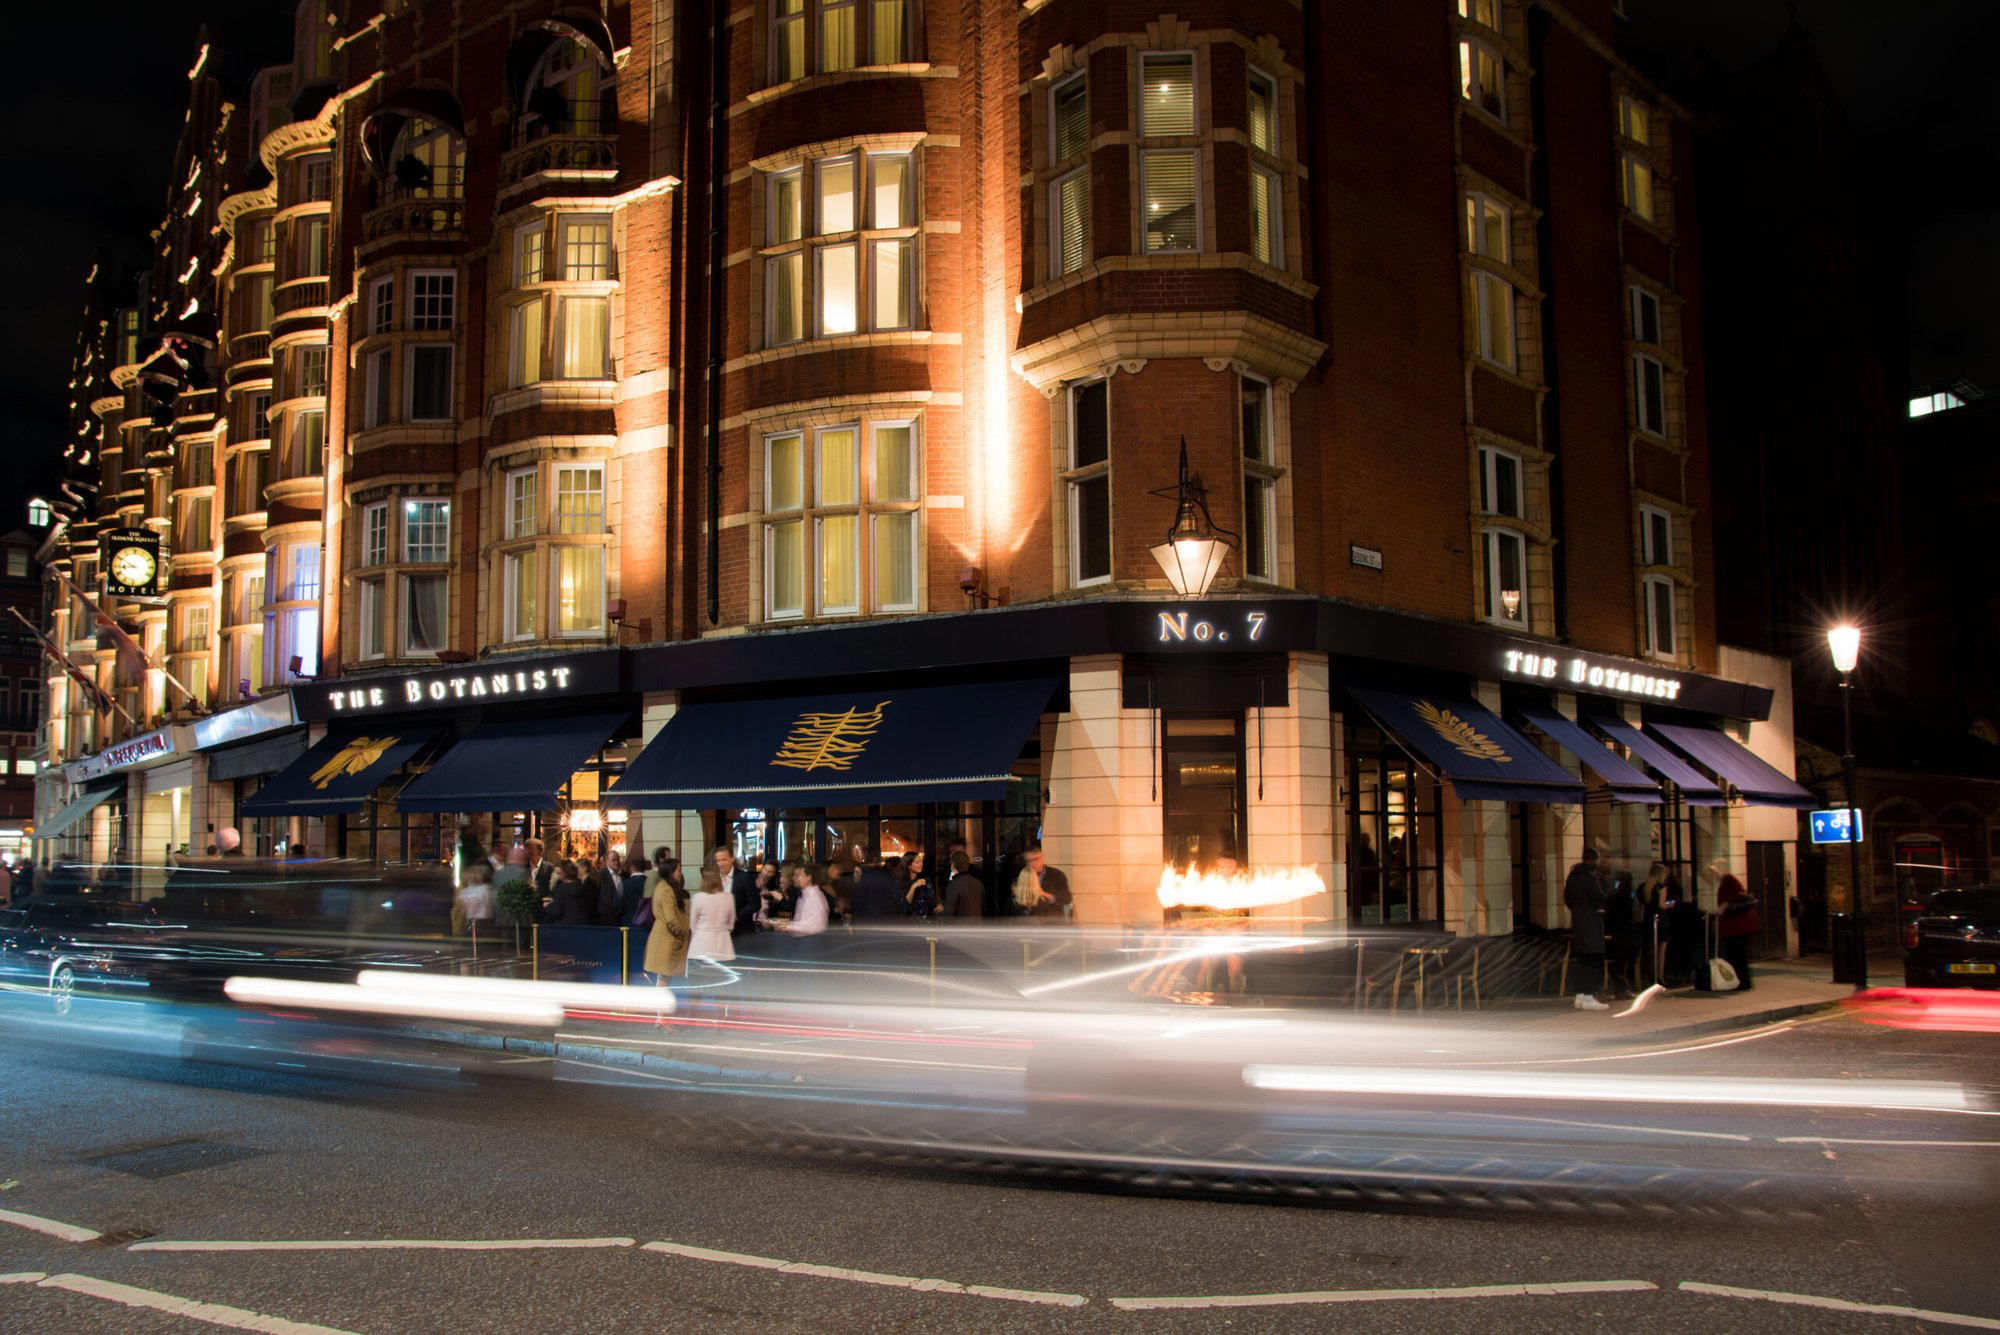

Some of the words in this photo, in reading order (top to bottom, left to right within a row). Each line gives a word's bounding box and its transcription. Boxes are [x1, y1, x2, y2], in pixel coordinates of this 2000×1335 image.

[109, 586, 155, 594] HOTEL
[1159, 612, 1229, 641] No.
[1247, 612, 1267, 641] 7
[329, 688, 384, 710] THE
[405, 667, 570, 703] BOTANIST
[1506, 650, 1558, 678] THE
[1571, 659, 1681, 700] BOTANIST
